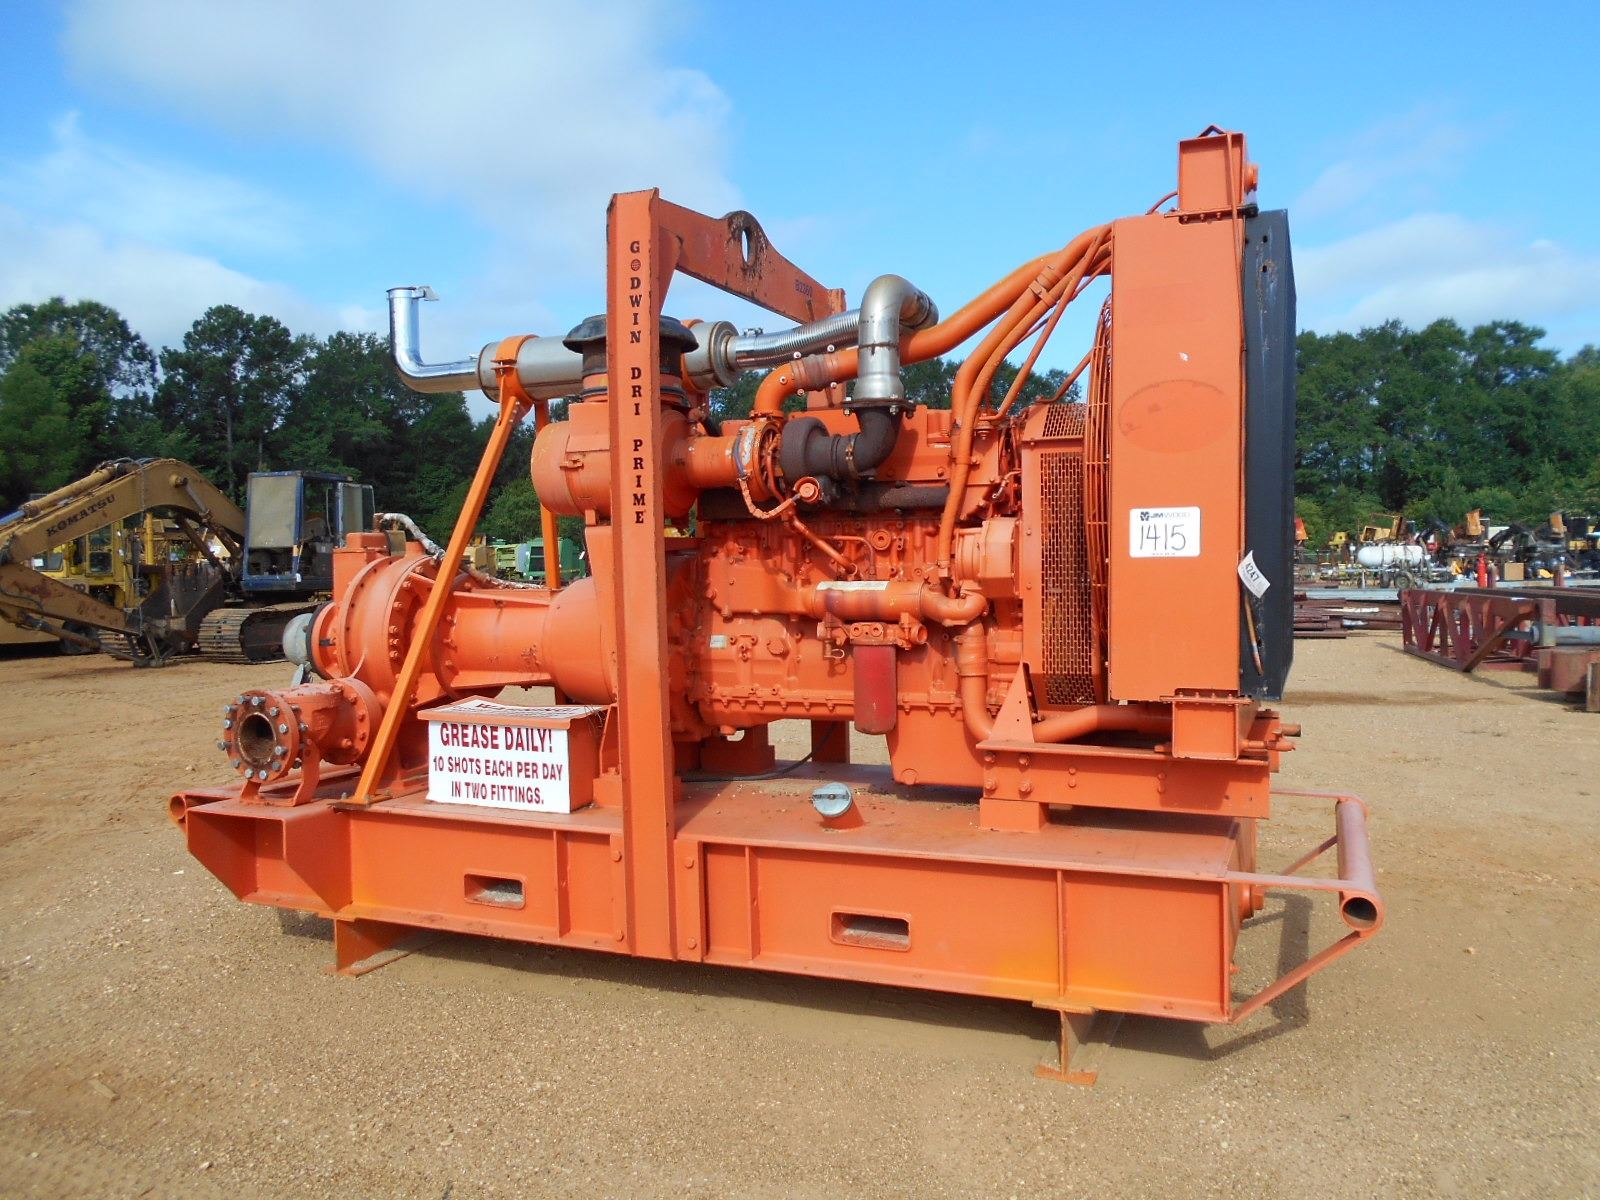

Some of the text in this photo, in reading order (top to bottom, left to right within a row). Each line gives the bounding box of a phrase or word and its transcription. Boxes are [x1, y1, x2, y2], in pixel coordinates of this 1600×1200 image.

[631, 367, 642, 415] DRI
[633, 439, 645, 523] PRIME
[46, 494, 116, 536] KOMATSU
[1140, 523, 1187, 551] 1415
[440, 723, 553, 752] GREASE DAILY!
[433, 756, 563, 780] 10 SHOTS EACH PER DAY
[452, 781, 544, 804] IN TWO FITTINGS.
